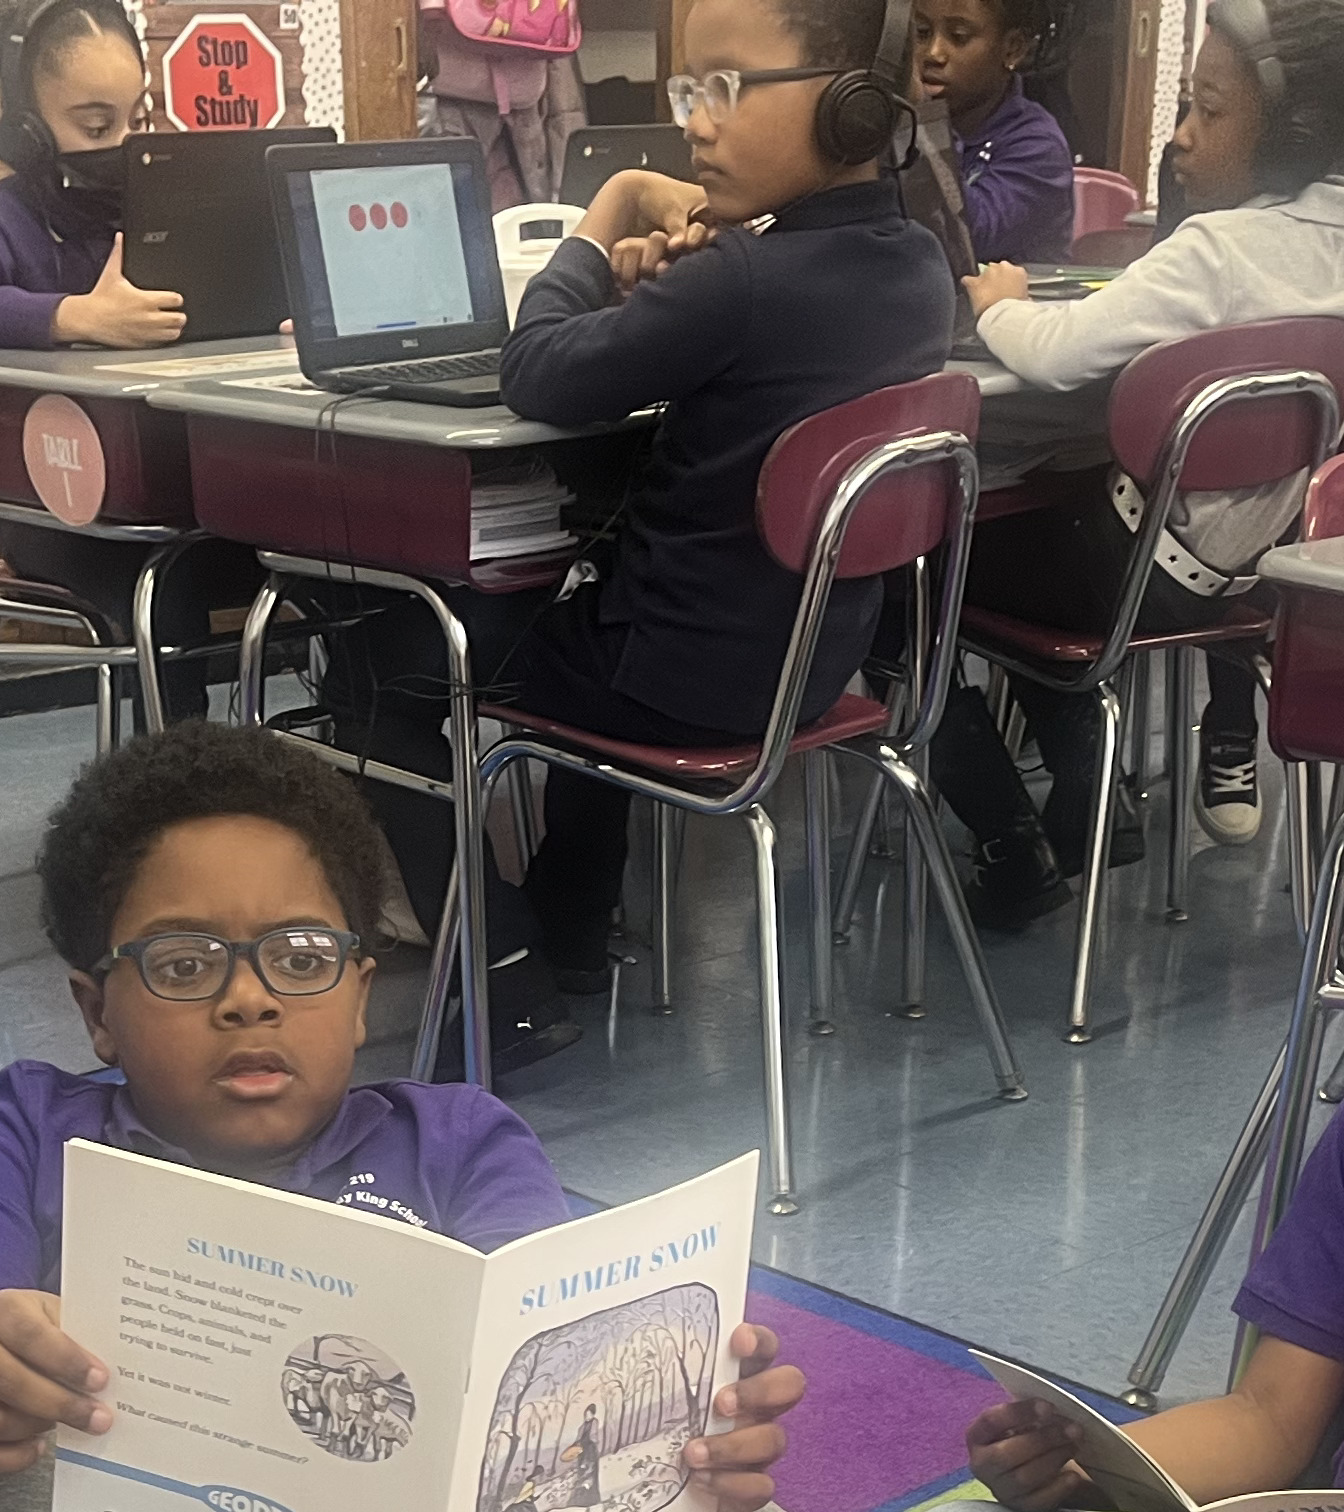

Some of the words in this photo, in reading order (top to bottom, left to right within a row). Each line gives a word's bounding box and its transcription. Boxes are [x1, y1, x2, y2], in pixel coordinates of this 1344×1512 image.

[196, 34, 249, 69] Stop
[217, 69, 233, 96] &
[194, 94, 259, 129] Study
[349, 1172, 375, 1185] 219
[356, 1190, 388, 1209] King
[123, 1256, 146, 1271] The
[194, 1277, 217, 1291] and
[218, 1284, 243, 1299] cold
[187, 1237, 285, 1279] SUMMER
[289, 1266, 359, 1298] SNOW
[519, 1255, 642, 1316] SUMMER
[649, 1221, 722, 1272] SNOW
[122, 1276, 141, 1289] the
[174, 1289, 209, 1306] Snow
[116, 1365, 135, 1380] Yet
[116, 1400, 147, 1418] What
